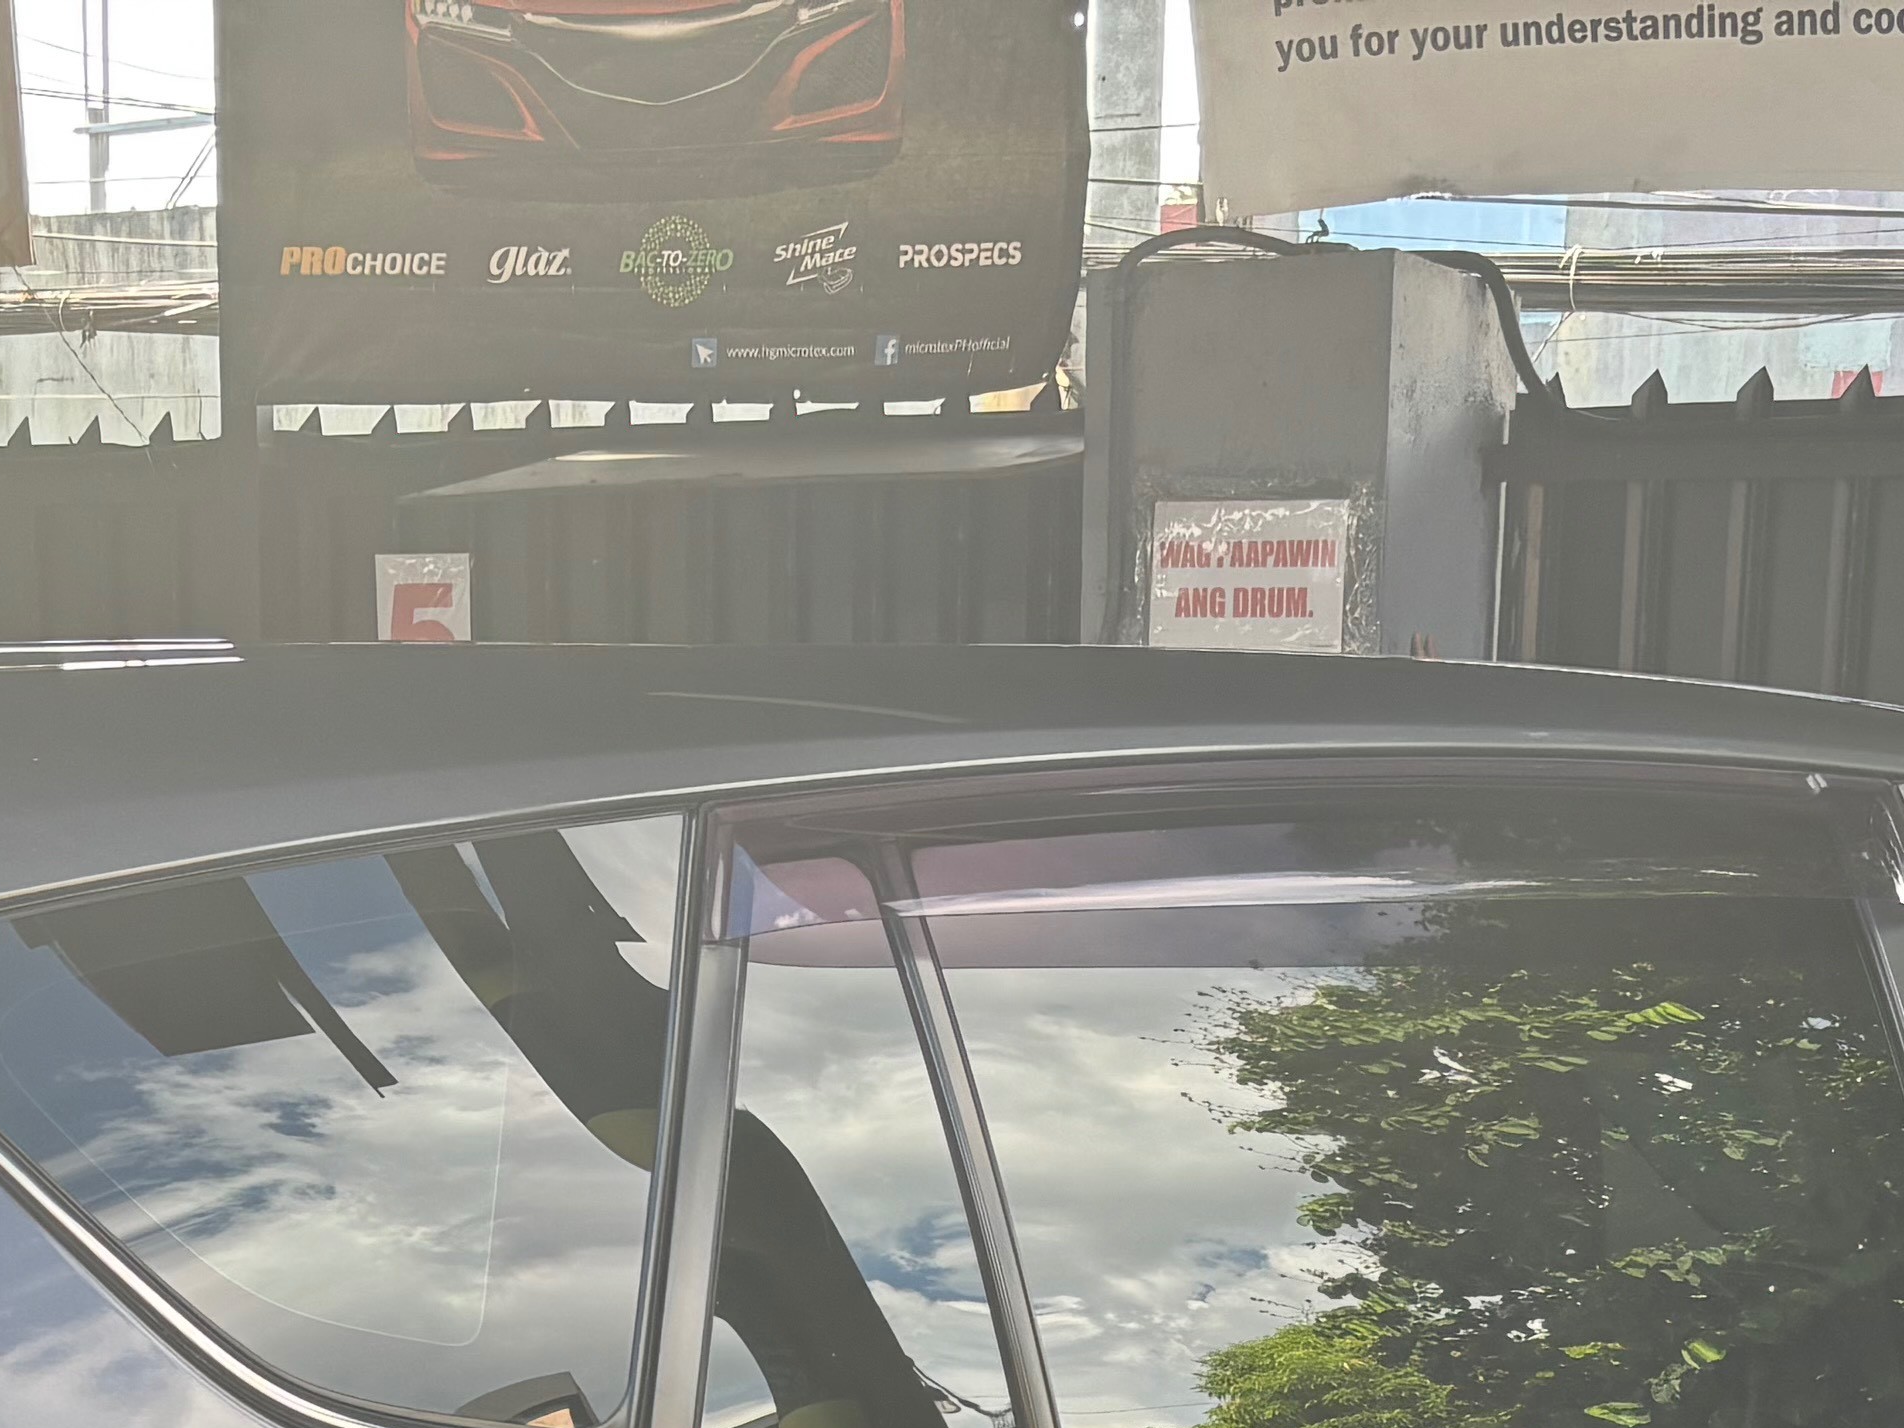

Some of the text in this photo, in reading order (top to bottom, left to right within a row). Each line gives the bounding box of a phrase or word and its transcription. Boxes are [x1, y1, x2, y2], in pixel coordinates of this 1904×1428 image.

[1276, 34, 1339, 72] you
[1350, 23, 1399, 57] for
[1410, 22, 1488, 61] your
[1499, 3, 1764, 47] understanding
[1774, 1, 1840, 37] and
[279, 245, 446, 277] PROCHOICE
[619, 248, 734, 273] BAC-TO-ZERO
[773, 234, 835, 263] Shine
[800, 246, 857, 272] Mate
[899, 242, 1022, 268] PROSPECS
[1160, 539, 1211, 568] WAG
[391, 582, 455, 641] 5
[1175, 587, 1314, 618] ANG DRUM.
